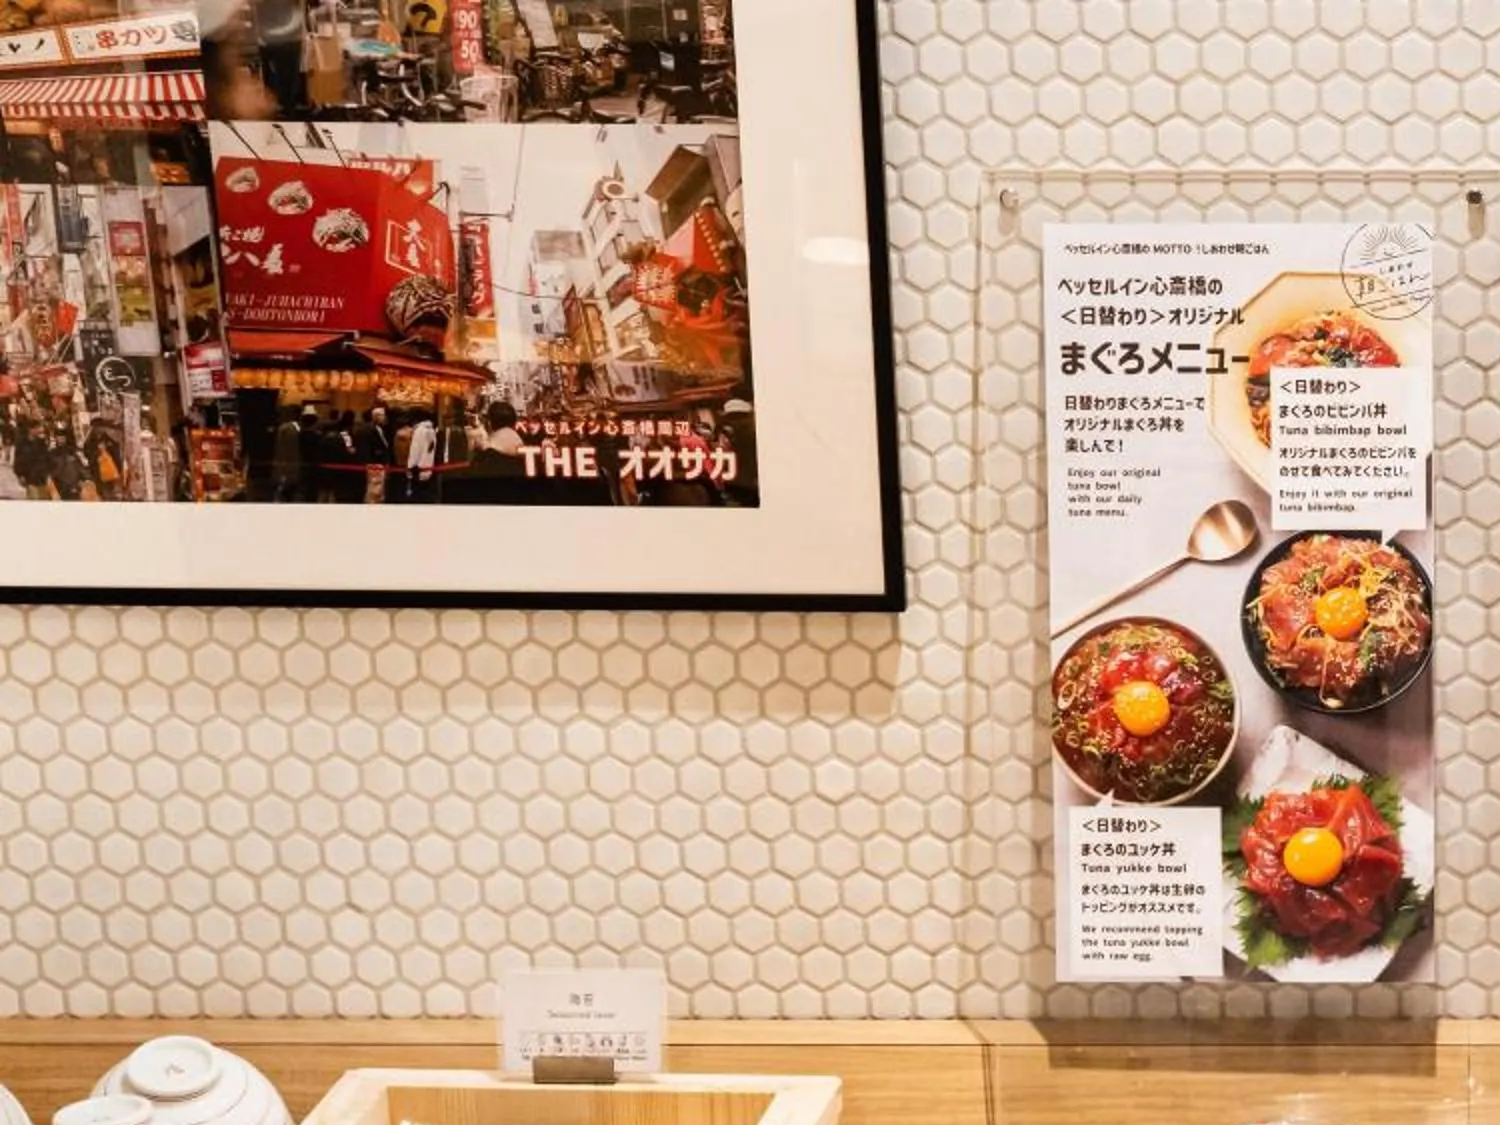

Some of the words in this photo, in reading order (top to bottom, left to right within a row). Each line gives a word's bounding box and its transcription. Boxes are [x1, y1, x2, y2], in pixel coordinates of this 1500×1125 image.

[1058, 275, 1222, 296] ベッセルイン心斎橋の
[1060, 341, 1250, 375] まぐろメニュー
[1065, 395, 1205, 411] 日替わりまぐろメニューで
[1064, 416, 1185, 432] オリジナルまぐろ丼を
[1279, 425, 1309, 435] Tuna
[1314, 425, 1371, 437] bibimbap
[1377, 424, 1408, 435] bowl
[517, 447, 598, 477] THE
[619, 447, 737, 480] オオサカ
[1081, 842, 1177, 857] まぐろのユッケ丼
[1081, 864, 1111, 873] Tuna
[1116, 864, 1153, 875] yukke
[1157, 863, 1188, 873] bowl
